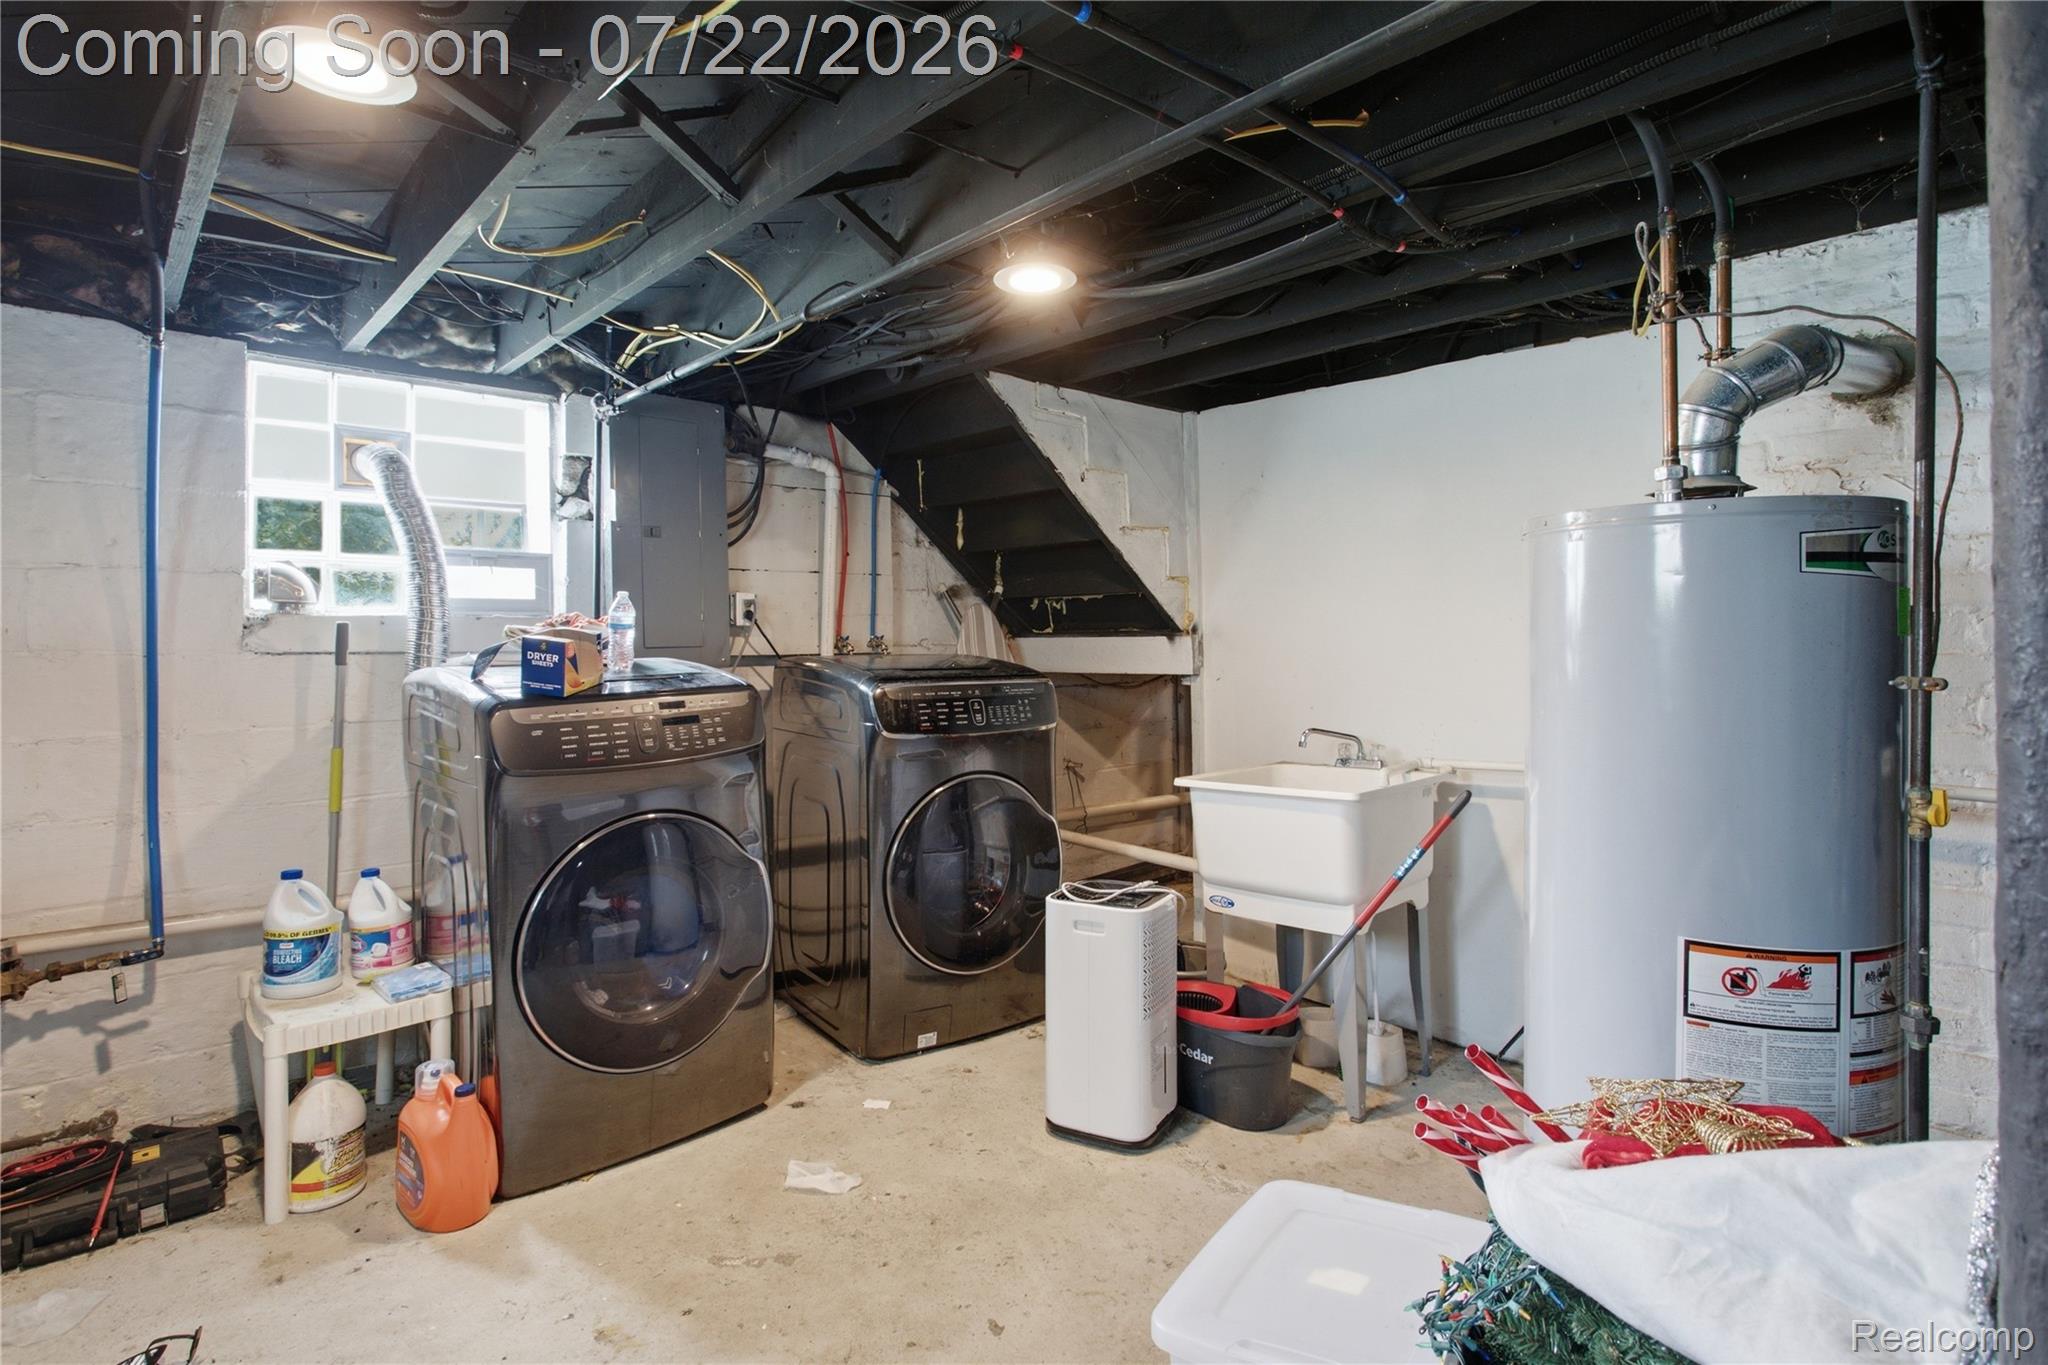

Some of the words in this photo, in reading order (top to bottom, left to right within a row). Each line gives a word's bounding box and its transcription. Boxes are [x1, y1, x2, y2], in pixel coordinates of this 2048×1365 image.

[527, 651, 559, 663] DRYER
[272, 954, 302, 965] BLEACH
[1753, 954, 1788, 962] WARNING
